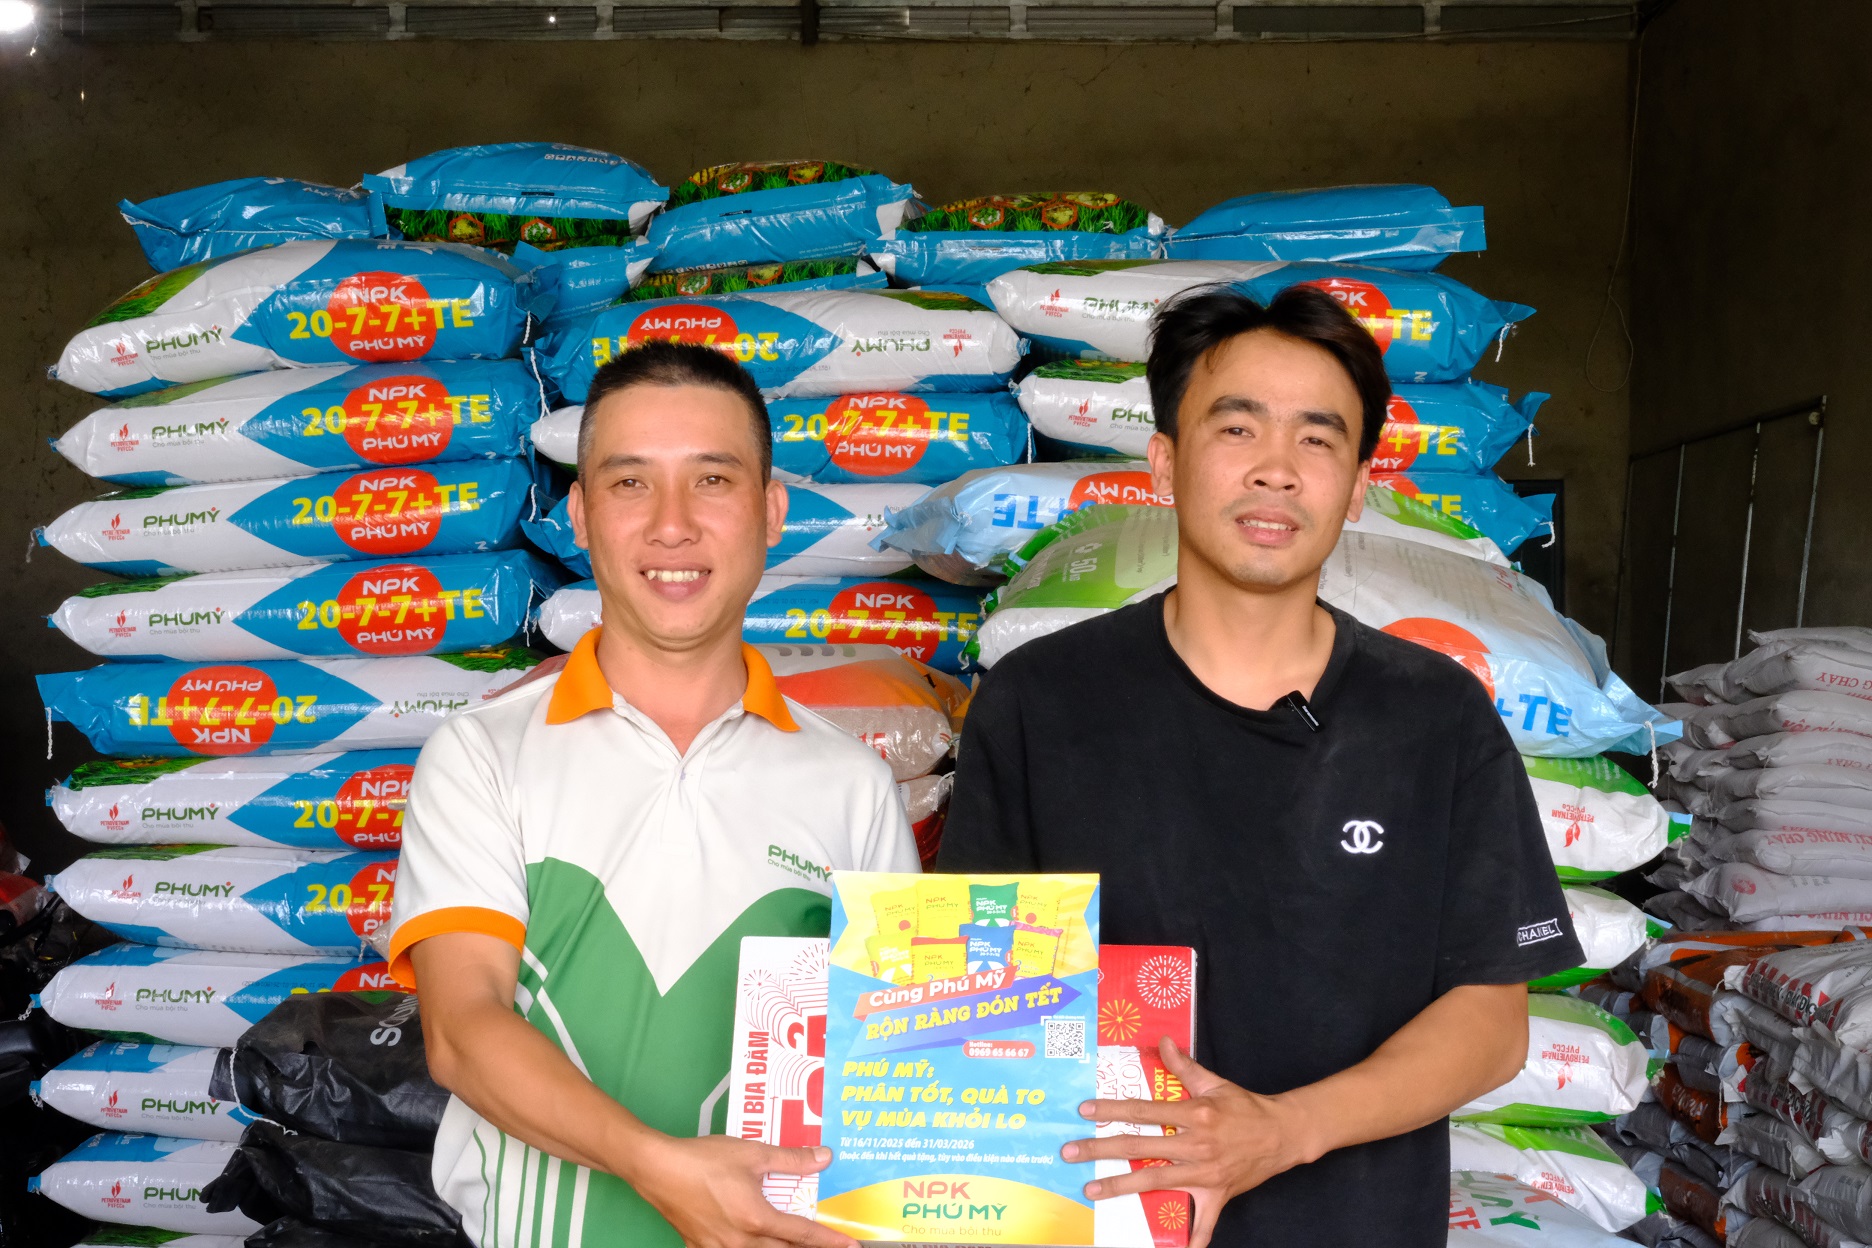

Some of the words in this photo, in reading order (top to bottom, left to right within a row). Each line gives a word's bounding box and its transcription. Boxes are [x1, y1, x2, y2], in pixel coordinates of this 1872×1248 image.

[349, 286, 408, 305] NPK
[287, 299, 474, 340] 20-7-7+TE
[674, 317, 722, 331] PHÚ
[350, 337, 394, 352] PHÚ
[369, 385, 427, 402] NPK
[849, 397, 907, 410] NPK
[301, 395, 492, 437] 20-7-7+TE
[363, 435, 409, 451] PHÚ
[836, 442, 882, 457] PHÚ
[360, 476, 417, 492] NPK
[292, 482, 480, 525] 20-7-7+TE
[351, 524, 398, 541] PHÚ
[363, 577, 420, 596] NPK
[297, 589, 485, 631] 20-7-7+TE
[855, 593, 915, 610] NPK
[357, 631, 403, 644] PHÚ
[216, 680, 263, 693] PHÚ
[129, 696, 318, 727] 20-7-7+TE
[191, 728, 251, 744] NPK
[354, 831, 401, 844] PHÚ
[870, 987, 924, 1008] Cùng
[930, 977, 970, 997] Phú
[976, 969, 1007, 990] Mỹ
[866, 1016, 910, 1042] RỘN
[915, 1006, 971, 1032] RÀNG
[976, 994, 1020, 1019] ĐÓN
[1026, 982, 1063, 1007] TẾT
[969, 1048, 991, 1057] 0969
[992, 1048, 1004, 1057] 65
[1005, 1048, 1016, 1057] 66
[1018, 1048, 1030, 1057] 67
[842, 1058, 890, 1077] PHÚ
[893, 1060, 935, 1079] MỸ:
[744, 1082, 765, 1114] BIA
[841, 1083, 905, 1102] PHÂN
[910, 1081, 954, 1106] TỐT,
[1016, 1089, 1046, 1106] TO
[841, 1110, 873, 1131] VỤ
[876, 1109, 927, 1128] MÙA
[933, 1107, 991, 1129] KHỎI
[996, 1114, 1027, 1130] LO
[841, 1137, 852, 1148] Từ
[853, 1138, 904, 1149] 16/11/2025
[905, 1137, 922, 1149] đến
[923, 1138, 975, 1150] 31/03/2026
[861, 1151, 875, 1161] đến
[876, 1151, 889, 1161] khi
[1016, 1154, 1031, 1164] đến
[903, 1181, 971, 1200] NPK
[902, 1203, 963, 1220] PHÚ
[902, 1225, 932, 1236] Cho
[982, 1226, 1002, 1237] thu
